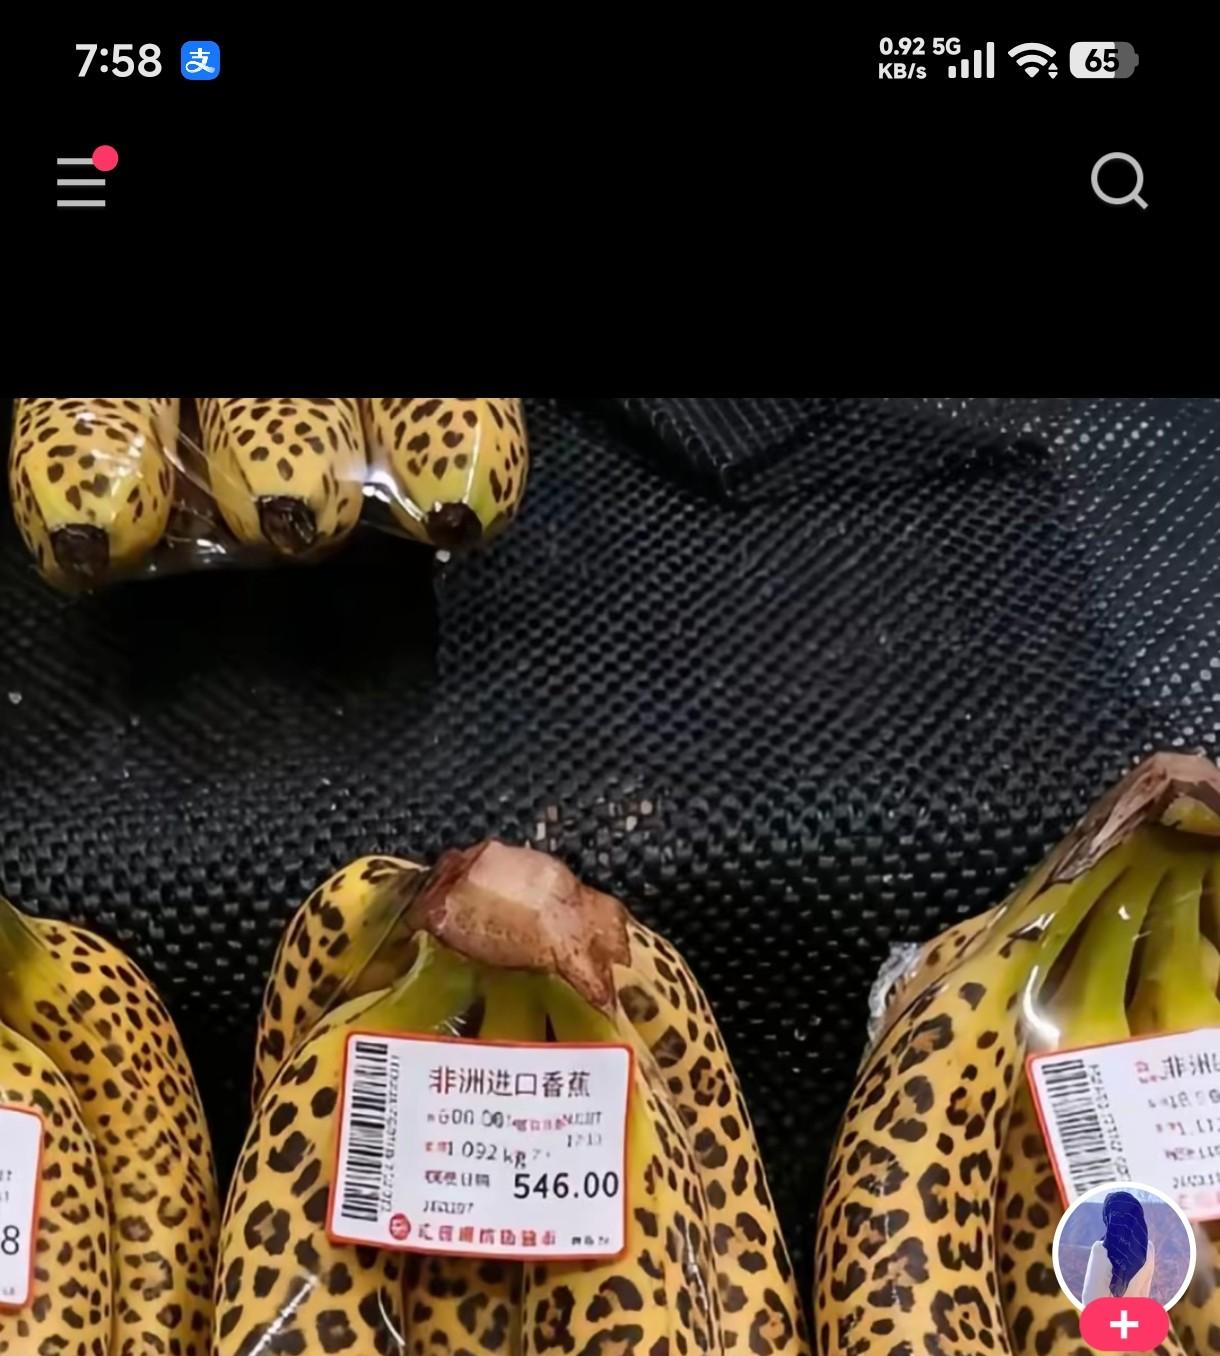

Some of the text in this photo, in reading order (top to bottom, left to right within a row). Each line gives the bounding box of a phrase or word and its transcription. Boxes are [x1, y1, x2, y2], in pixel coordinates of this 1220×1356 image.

[879, 36, 962, 56] 0.92 5G
[75, 44, 163, 78] 7:58
[878, 62, 927, 79] KB/s
[1085, 48, 1120, 73] 65
[428, 1066, 591, 1098] 非洲进口香蕉
[513, 1171, 619, 1199] 546.00
